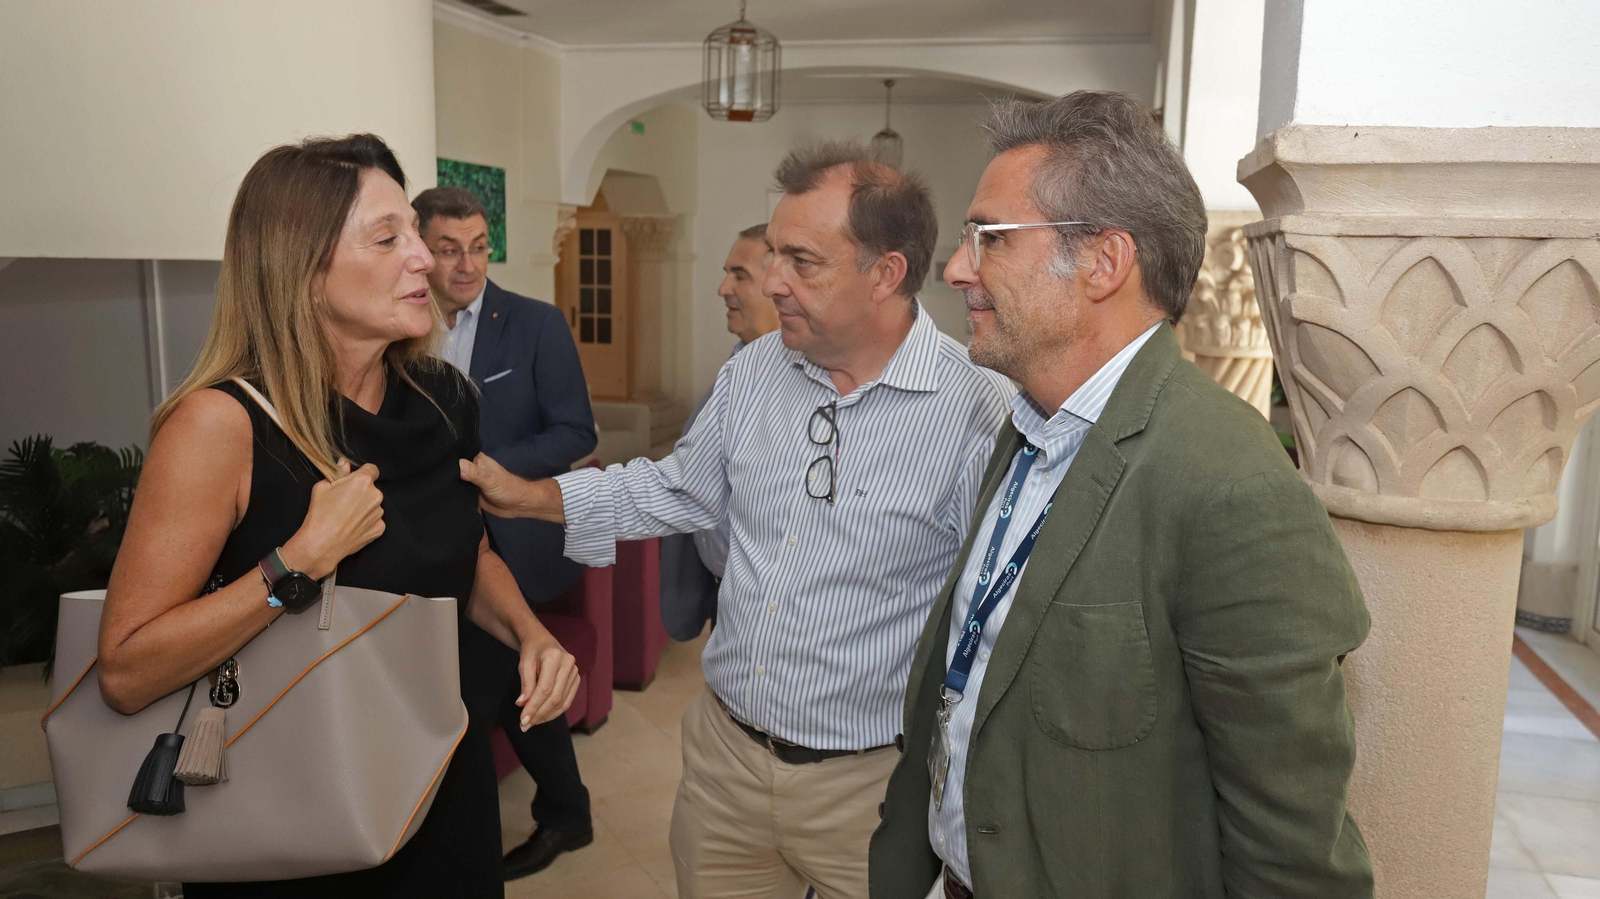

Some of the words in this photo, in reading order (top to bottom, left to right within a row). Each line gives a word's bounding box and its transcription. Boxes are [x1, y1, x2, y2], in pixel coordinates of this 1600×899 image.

[1005, 481, 1018, 509] Algeciras
[1031, 516, 1047, 540] Algecir
[983, 546, 996, 575] Algeciras
[993, 572, 1012, 599] Algeciras
[1006, 576, 1014, 587] Port
[962, 631, 976, 658] Algeciras
